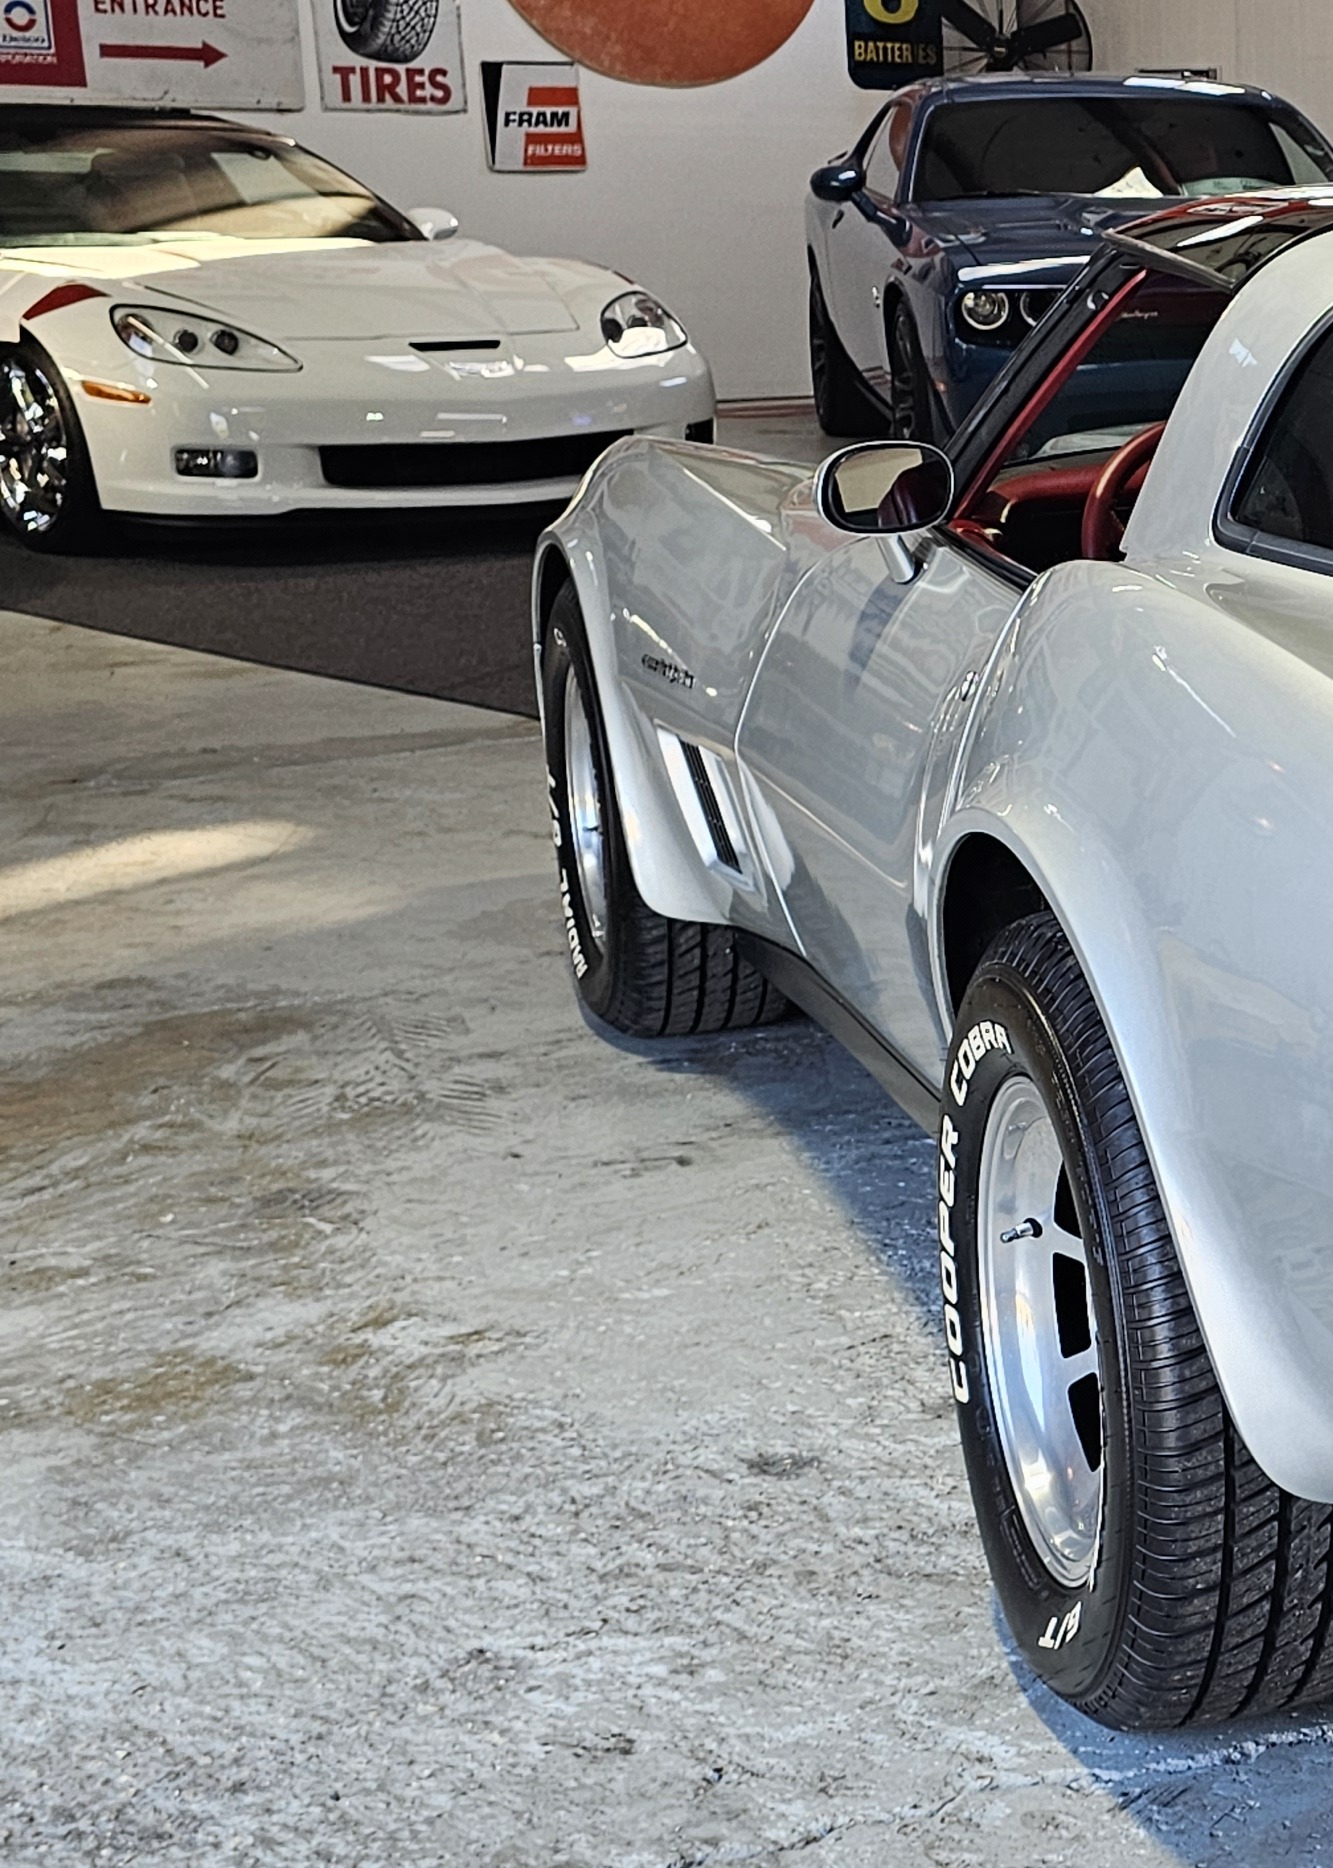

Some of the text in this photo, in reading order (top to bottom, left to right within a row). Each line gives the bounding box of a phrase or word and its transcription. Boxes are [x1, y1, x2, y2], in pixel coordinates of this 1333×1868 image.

[93, 0, 226, 18] ENTRANCE
[854, 40, 938, 65] BATTERIES
[332, 65, 452, 105] TIRES
[503, 111, 571, 128] FRAM
[526, 143, 582, 157] FILTERS
[939, 1020, 1012, 1403] COOPER COBRA
[1038, 1601, 1082, 1650] G/T
